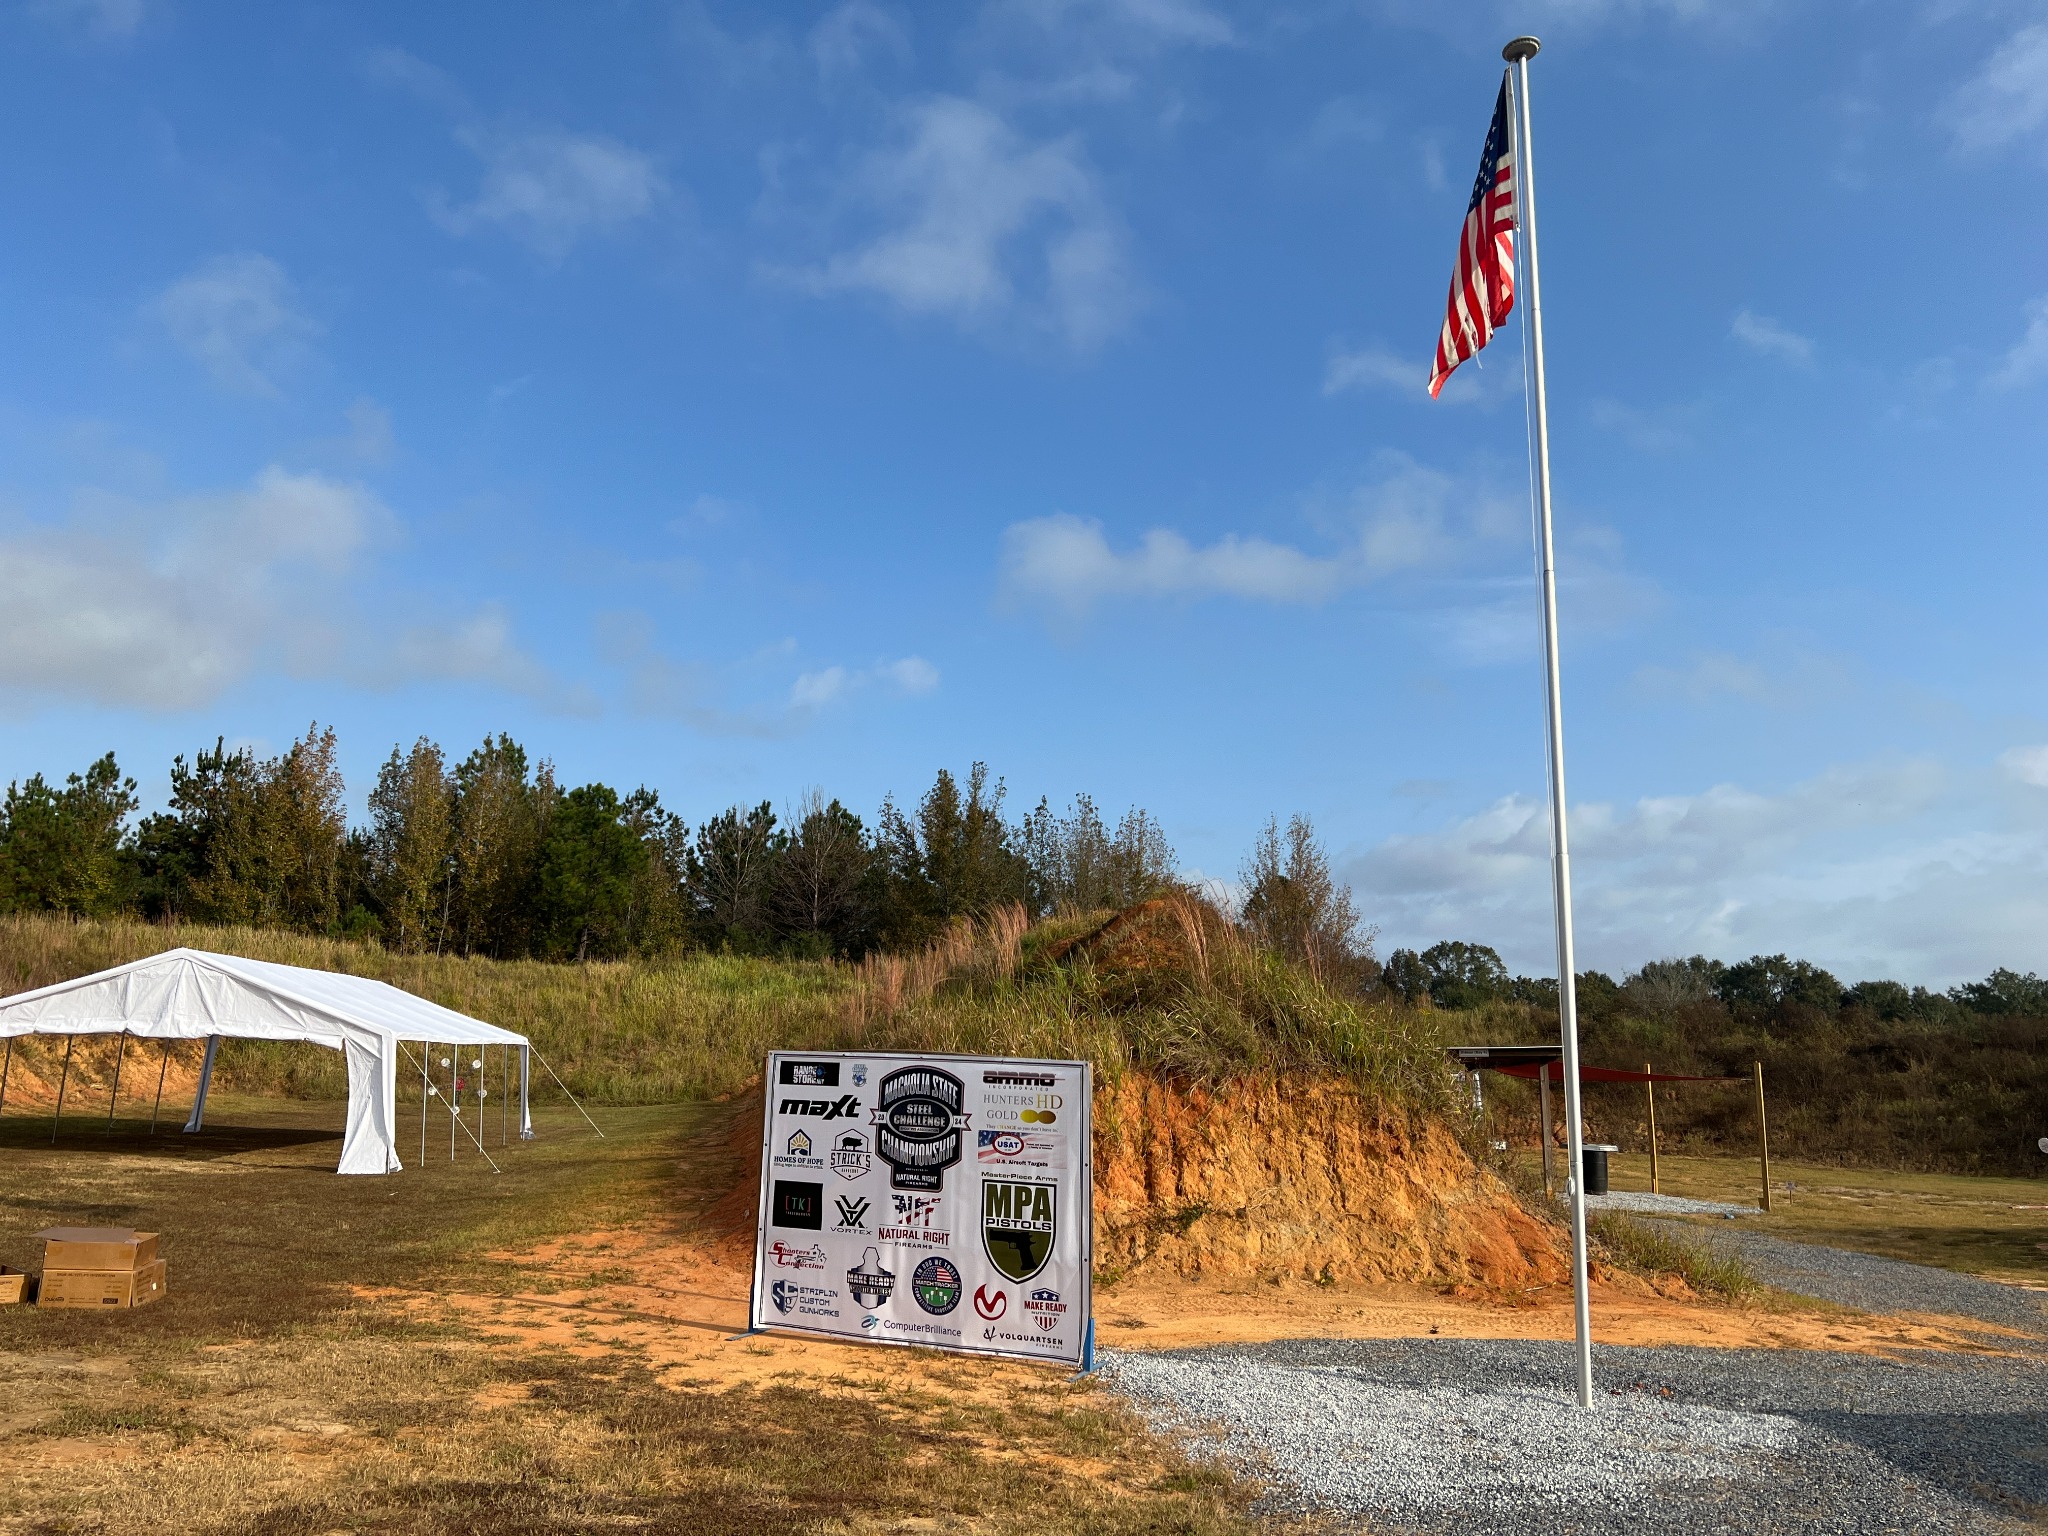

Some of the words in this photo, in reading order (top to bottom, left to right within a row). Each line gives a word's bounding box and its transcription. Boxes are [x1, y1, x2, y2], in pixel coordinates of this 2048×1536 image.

[794, 1065, 817, 1075] RANGE
[983, 1070, 1055, 1087] ammo
[884, 1073, 930, 1105] MAGNOLIA
[932, 1075, 958, 1109] STATE
[983, 1094, 1034, 1106] HUNTERS
[1036, 1093, 1063, 1109] HD
[906, 1103, 933, 1115] STEEL
[986, 1109, 1018, 1120] GOLD
[893, 1114, 946, 1127] CHALLENGE
[954, 1117, 962, 1125] 24
[881, 1130, 956, 1166] CHAMPIONSHIP
[997, 1141, 1019, 1149] USAT
[774, 1155, 797, 1164] HOMES
[807, 1158, 824, 1166] HOPE
[830, 1152, 871, 1168] STRICK'S
[895, 1173, 921, 1181] NATURAL
[921, 1175, 938, 1184] RIGHT
[981, 1172, 1032, 1180] MasterPiece
[986, 1184, 1052, 1222] MPA
[986, 1218, 1052, 1231] PISTOLS
[830, 1227, 873, 1236] VORTEX
[878, 1227, 920, 1240] NATURAL
[923, 1231, 950, 1246] RIGHT
[768, 1242, 810, 1256] Shooters
[894, 1241, 933, 1250] FIREARMS
[778, 1253, 824, 1270] Connection
[944, 1262, 958, 1279] TRUST
[847, 1273, 868, 1284] MAKE
[868, 1275, 895, 1287] READY
[800, 1287, 838, 1298] STRIPLIN
[799, 1296, 830, 1306] CUSTOM
[1024, 1300, 1043, 1311] MAKE
[1045, 1303, 1067, 1313] READY
[799, 1306, 840, 1318] GUNWORKS
[883, 1319, 962, 1336] ComputerBrilliance
[999, 1332, 1063, 1346] VOLQUARTSEN
